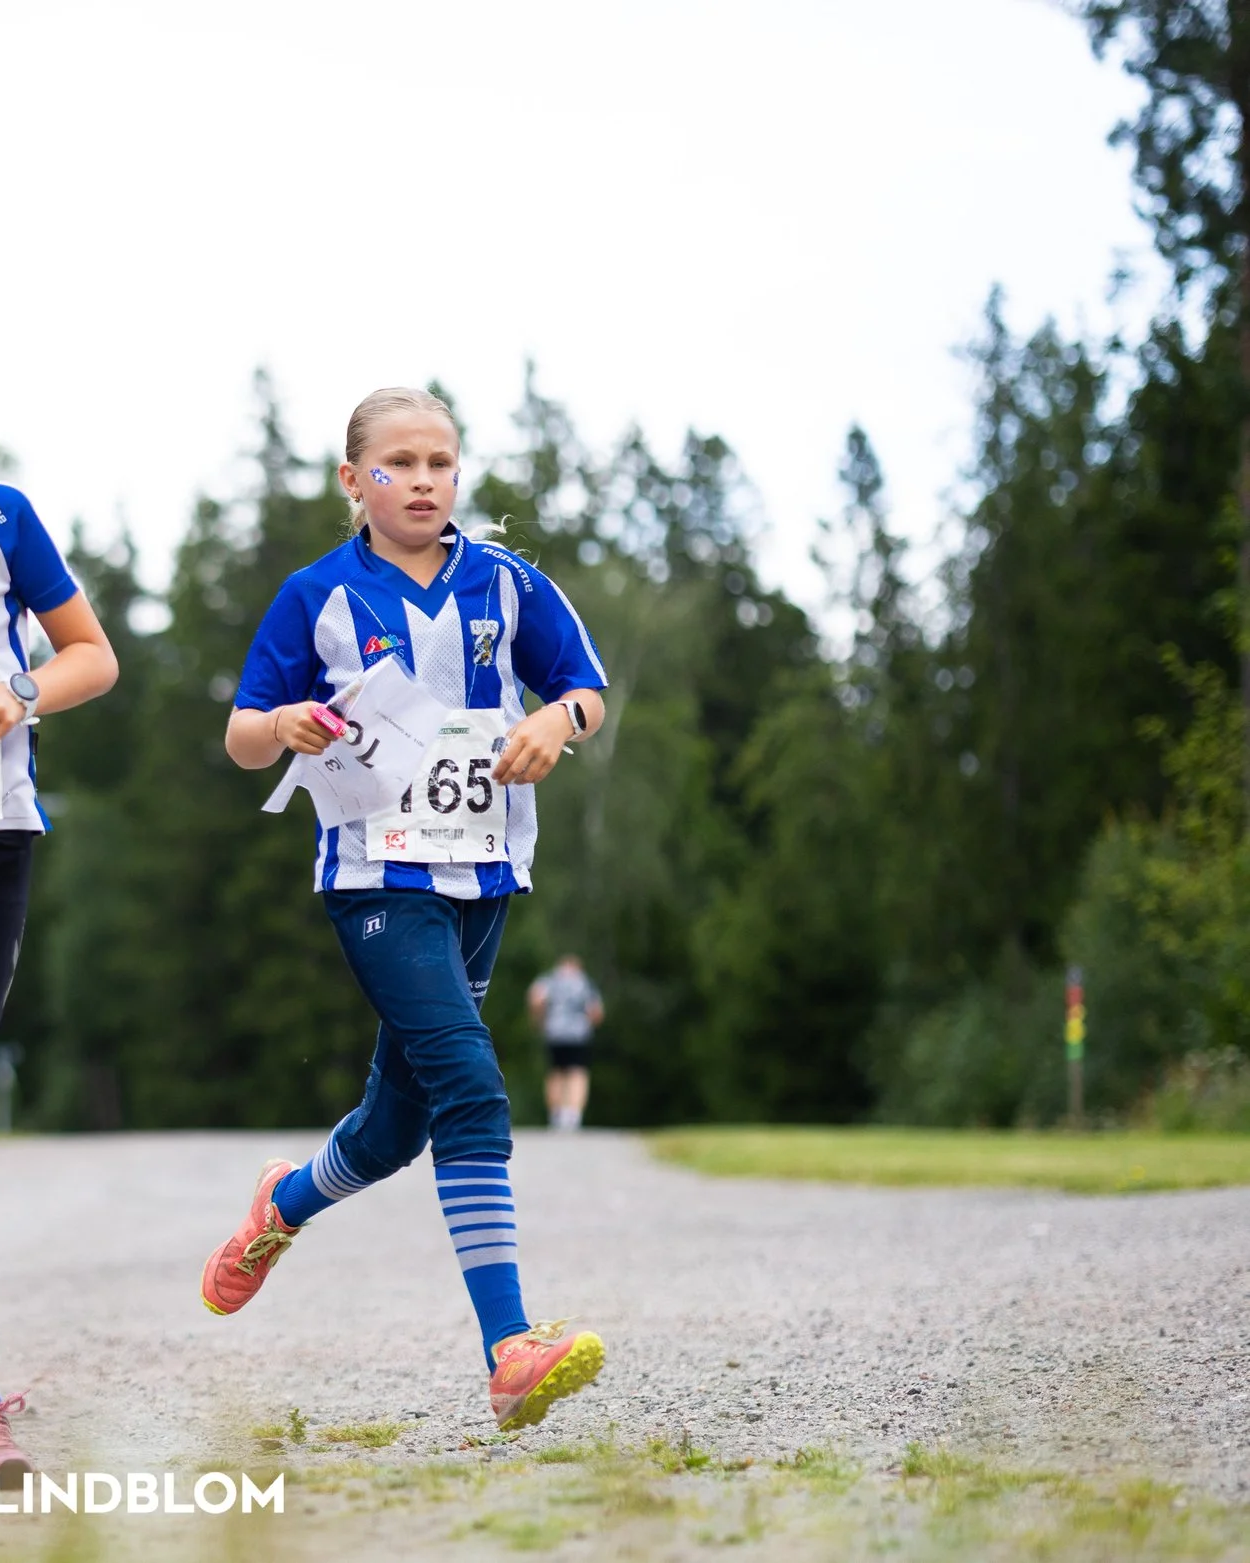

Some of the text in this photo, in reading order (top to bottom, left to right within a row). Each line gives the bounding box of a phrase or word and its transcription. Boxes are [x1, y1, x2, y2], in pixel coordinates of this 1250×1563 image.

[441, 532, 464, 584] nonam
[481, 547, 533, 593] noname
[485, 834, 495, 853] 3
